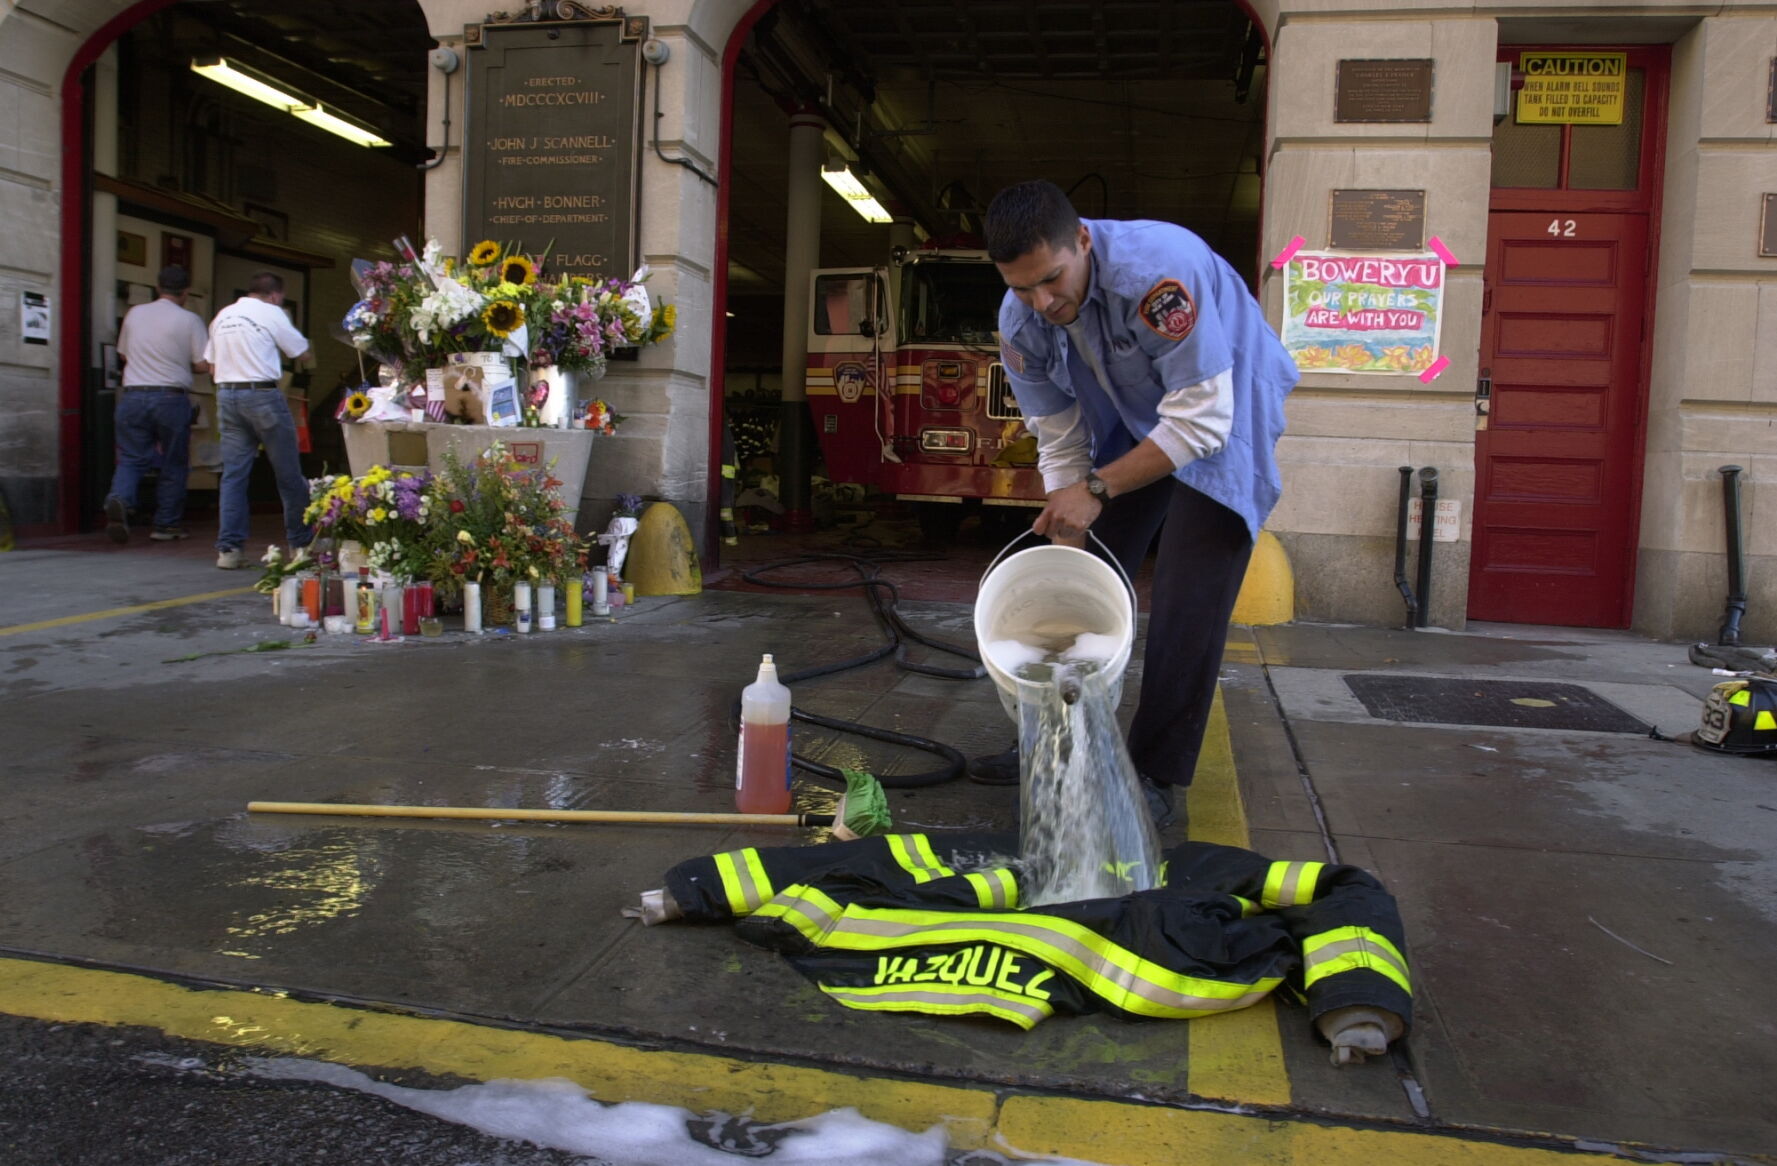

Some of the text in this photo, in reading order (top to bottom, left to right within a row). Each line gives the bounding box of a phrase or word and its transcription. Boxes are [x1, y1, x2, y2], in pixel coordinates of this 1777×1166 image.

[1527, 59, 1619, 75] CAUTION
[529, 77, 575, 87] ERECTED
[1524, 81, 1620, 92] WHEN ALARM BELL SOUNDS
[505, 91, 599, 107] MDCCCXCVIII
[1524, 94, 1617, 104] TANK FILLED TO CAPACITY
[1539, 106, 1600, 118] DO NOT OVERFILL
[490, 137, 525, 151] JOHN
[543, 135, 612, 149] SCANNELL
[543, 195, 600, 208] BONNER
[1548, 219, 1576, 237] 42
[1302, 259, 1439, 286] BOWERY U
[1308, 291, 1418, 307] OUR PRAYERS
[1308, 311, 1418, 327] ARE WITH YOU
[1414, 501, 1454, 511] HSE
[1703, 705, 1725, 730] 33
[874, 945, 1056, 1001] VAZQUEZ
